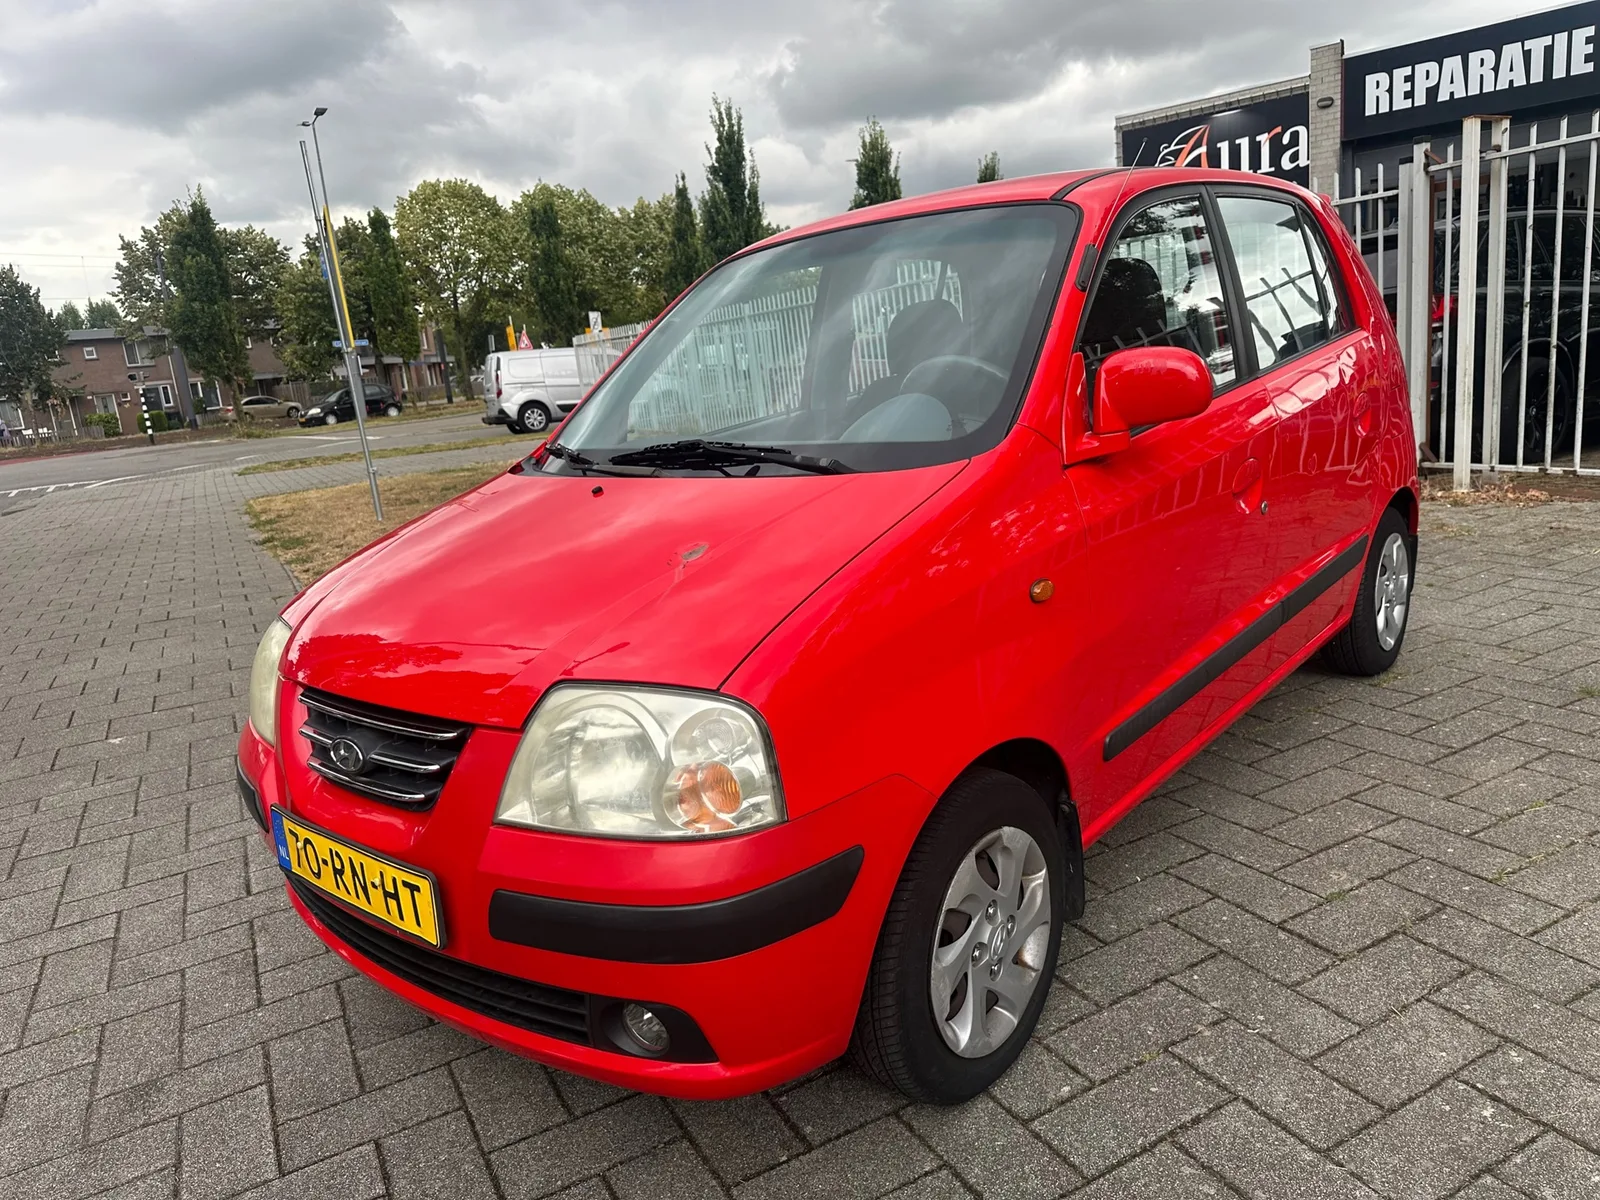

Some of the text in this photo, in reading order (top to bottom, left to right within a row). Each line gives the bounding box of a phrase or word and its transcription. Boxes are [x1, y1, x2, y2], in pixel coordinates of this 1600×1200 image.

[1364, 25, 1596, 117] REPARATIE
[1173, 124, 1310, 174] Aura
[278, 844, 290, 861] NL
[288, 829, 421, 928] 70-RN-HT
